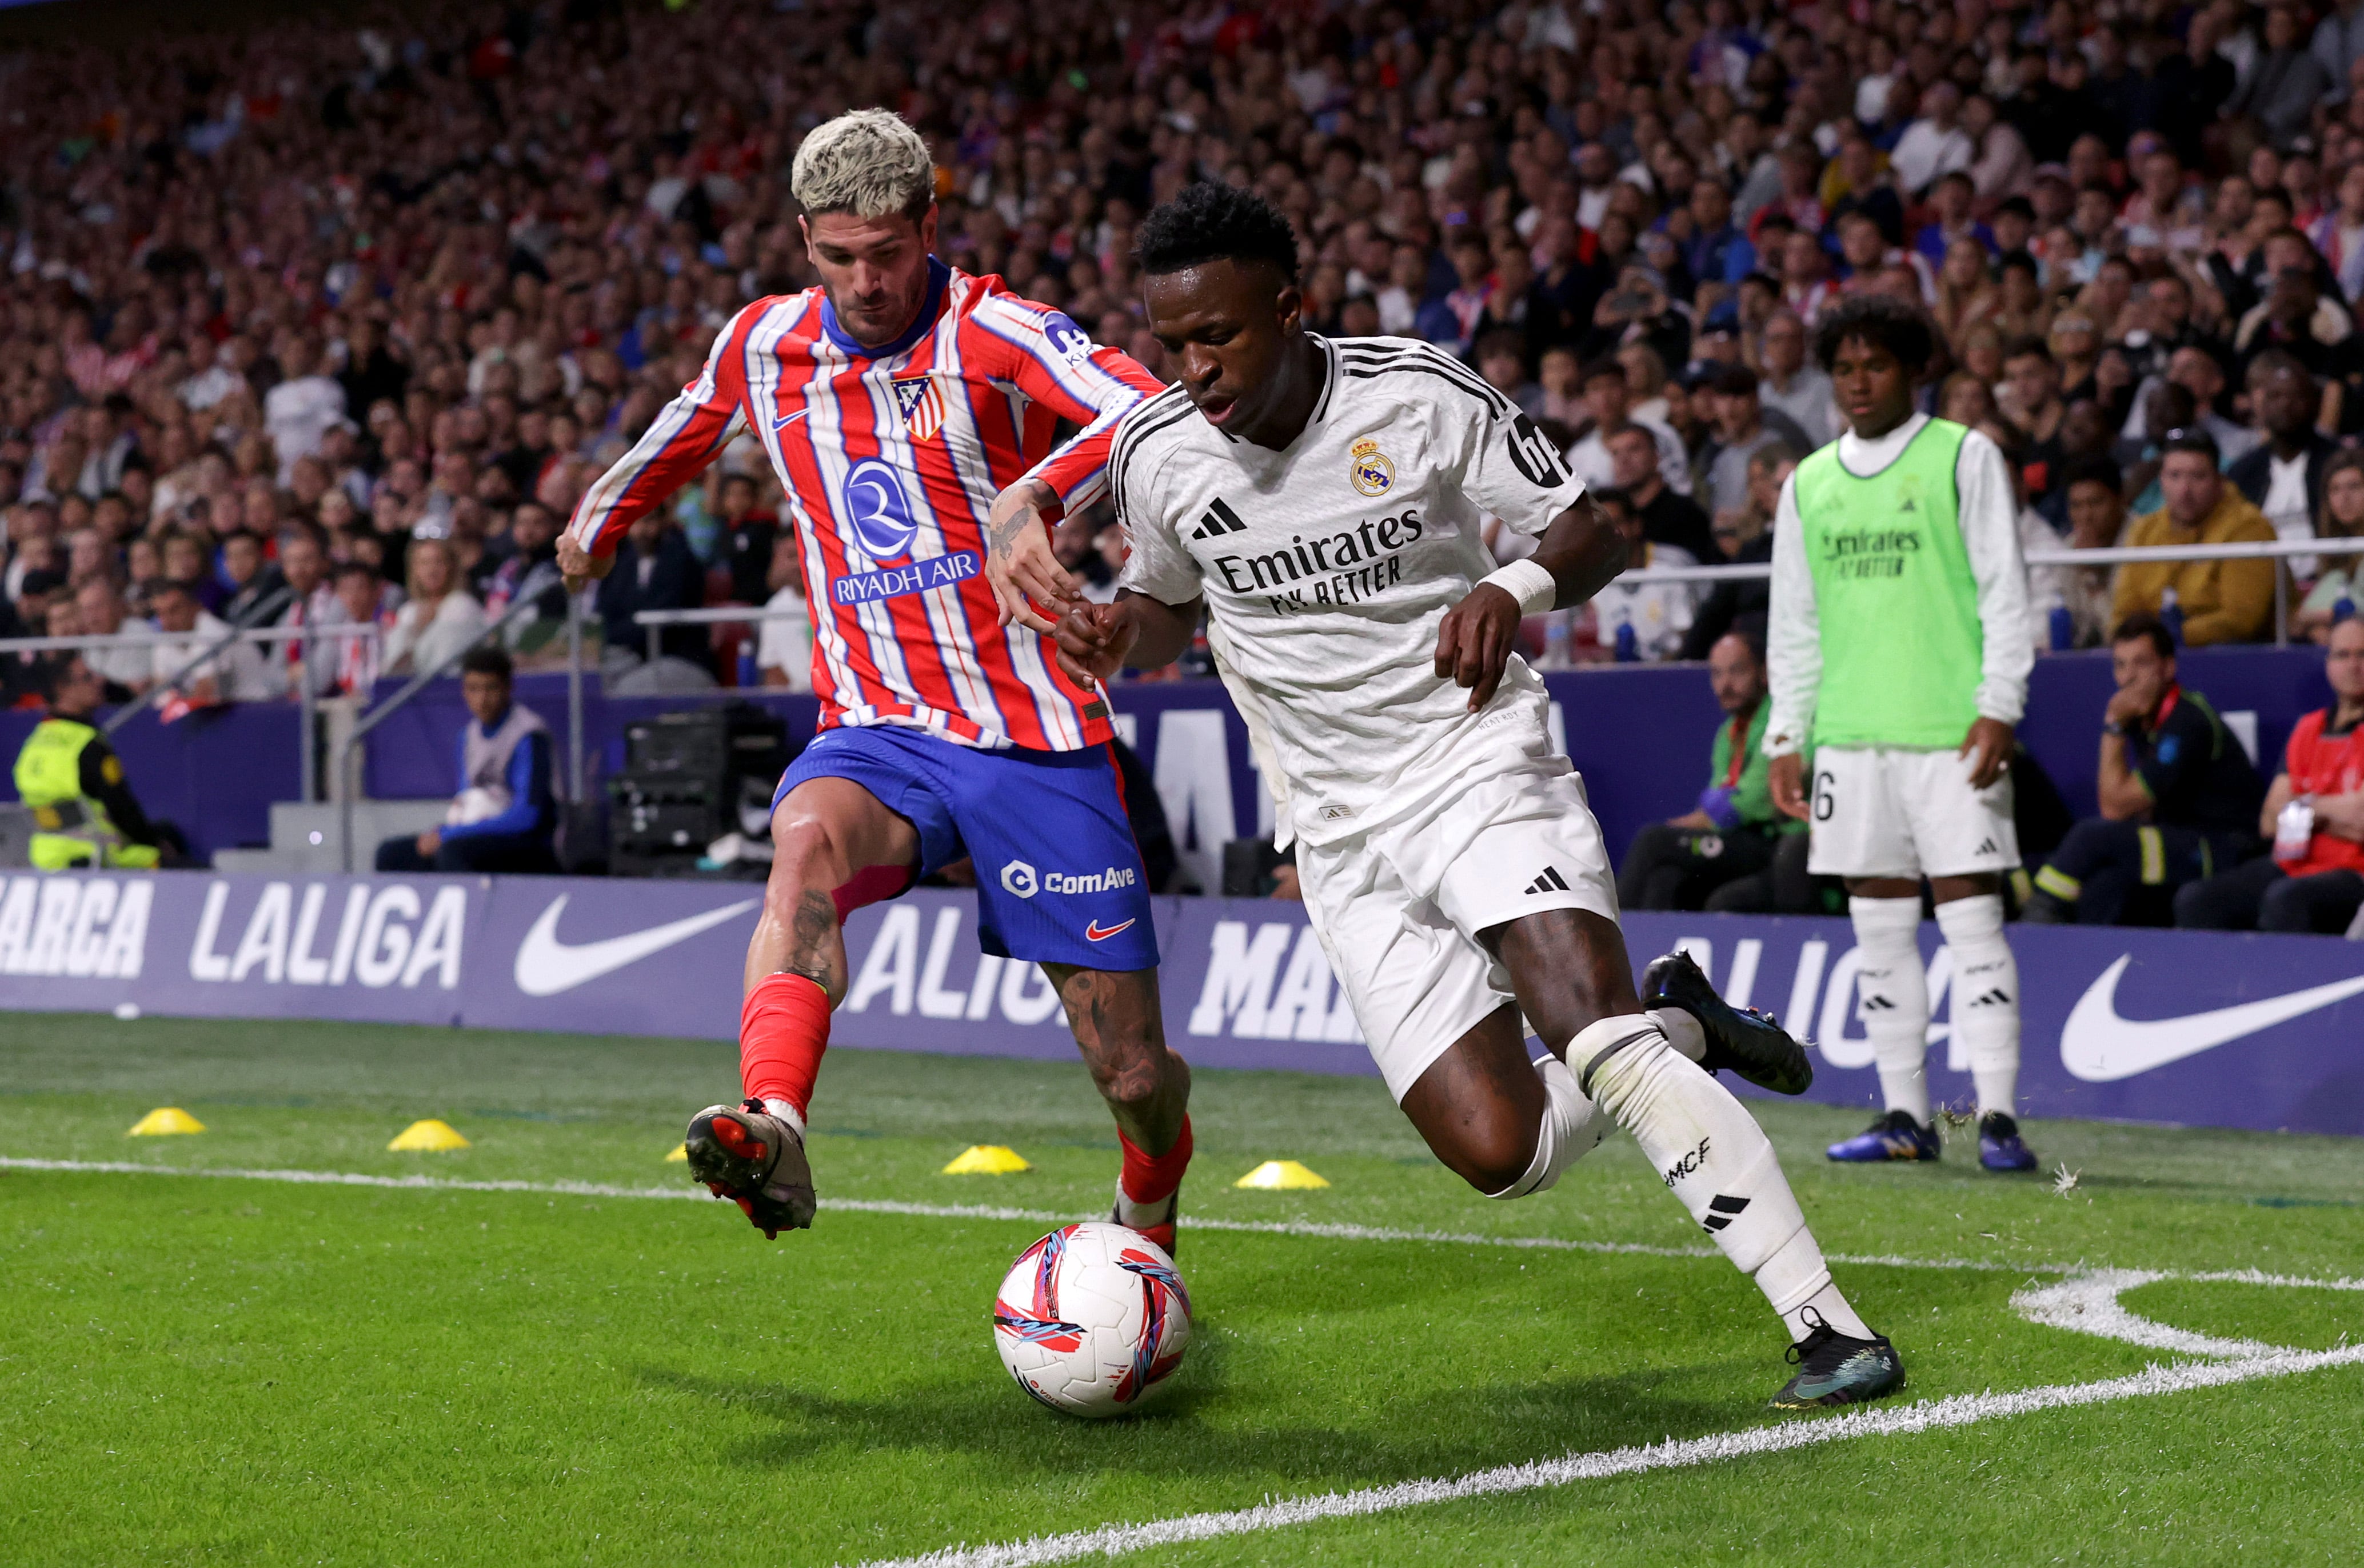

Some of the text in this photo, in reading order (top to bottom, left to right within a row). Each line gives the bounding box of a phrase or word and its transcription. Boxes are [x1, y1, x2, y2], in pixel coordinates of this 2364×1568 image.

[1065, 346, 1095, 366] kra
[837, 554, 976, 603] RIYADH AIR
[1213, 509, 1422, 593] Emirates
[1314, 555, 1401, 606] BETTER
[1044, 866, 1135, 895] ComAve
[0, 875, 155, 979] ARCA
[189, 880, 467, 990] LALIGA
[834, 904, 1070, 1027] ALIG
[1188, 921, 1365, 1044] MA
